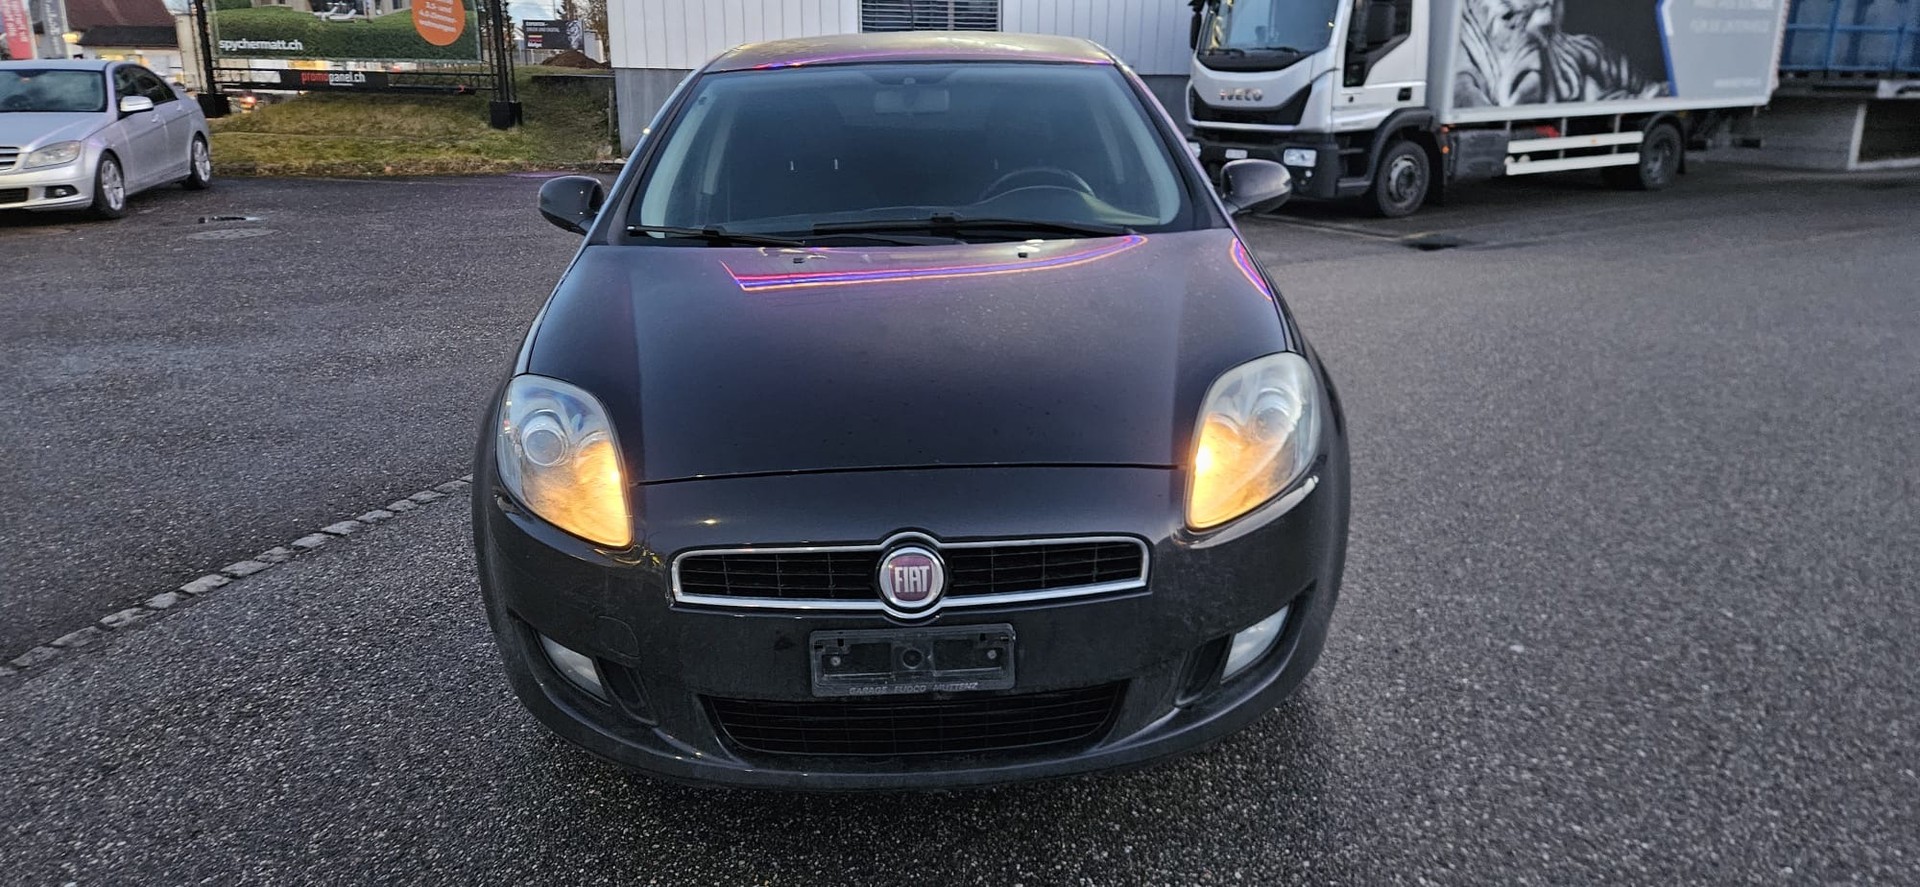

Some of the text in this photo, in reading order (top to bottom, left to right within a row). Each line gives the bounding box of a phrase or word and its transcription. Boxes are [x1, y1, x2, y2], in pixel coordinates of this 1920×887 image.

[218, 38, 304, 51] spychermatt.ch
[300, 71, 366, 85] promopanel.ch
[1219, 87, 1264, 101] IVECO
[893, 565, 930, 593] FIAT
[849, 682, 979, 695] GARAGE FUOCO MUTTENZ
